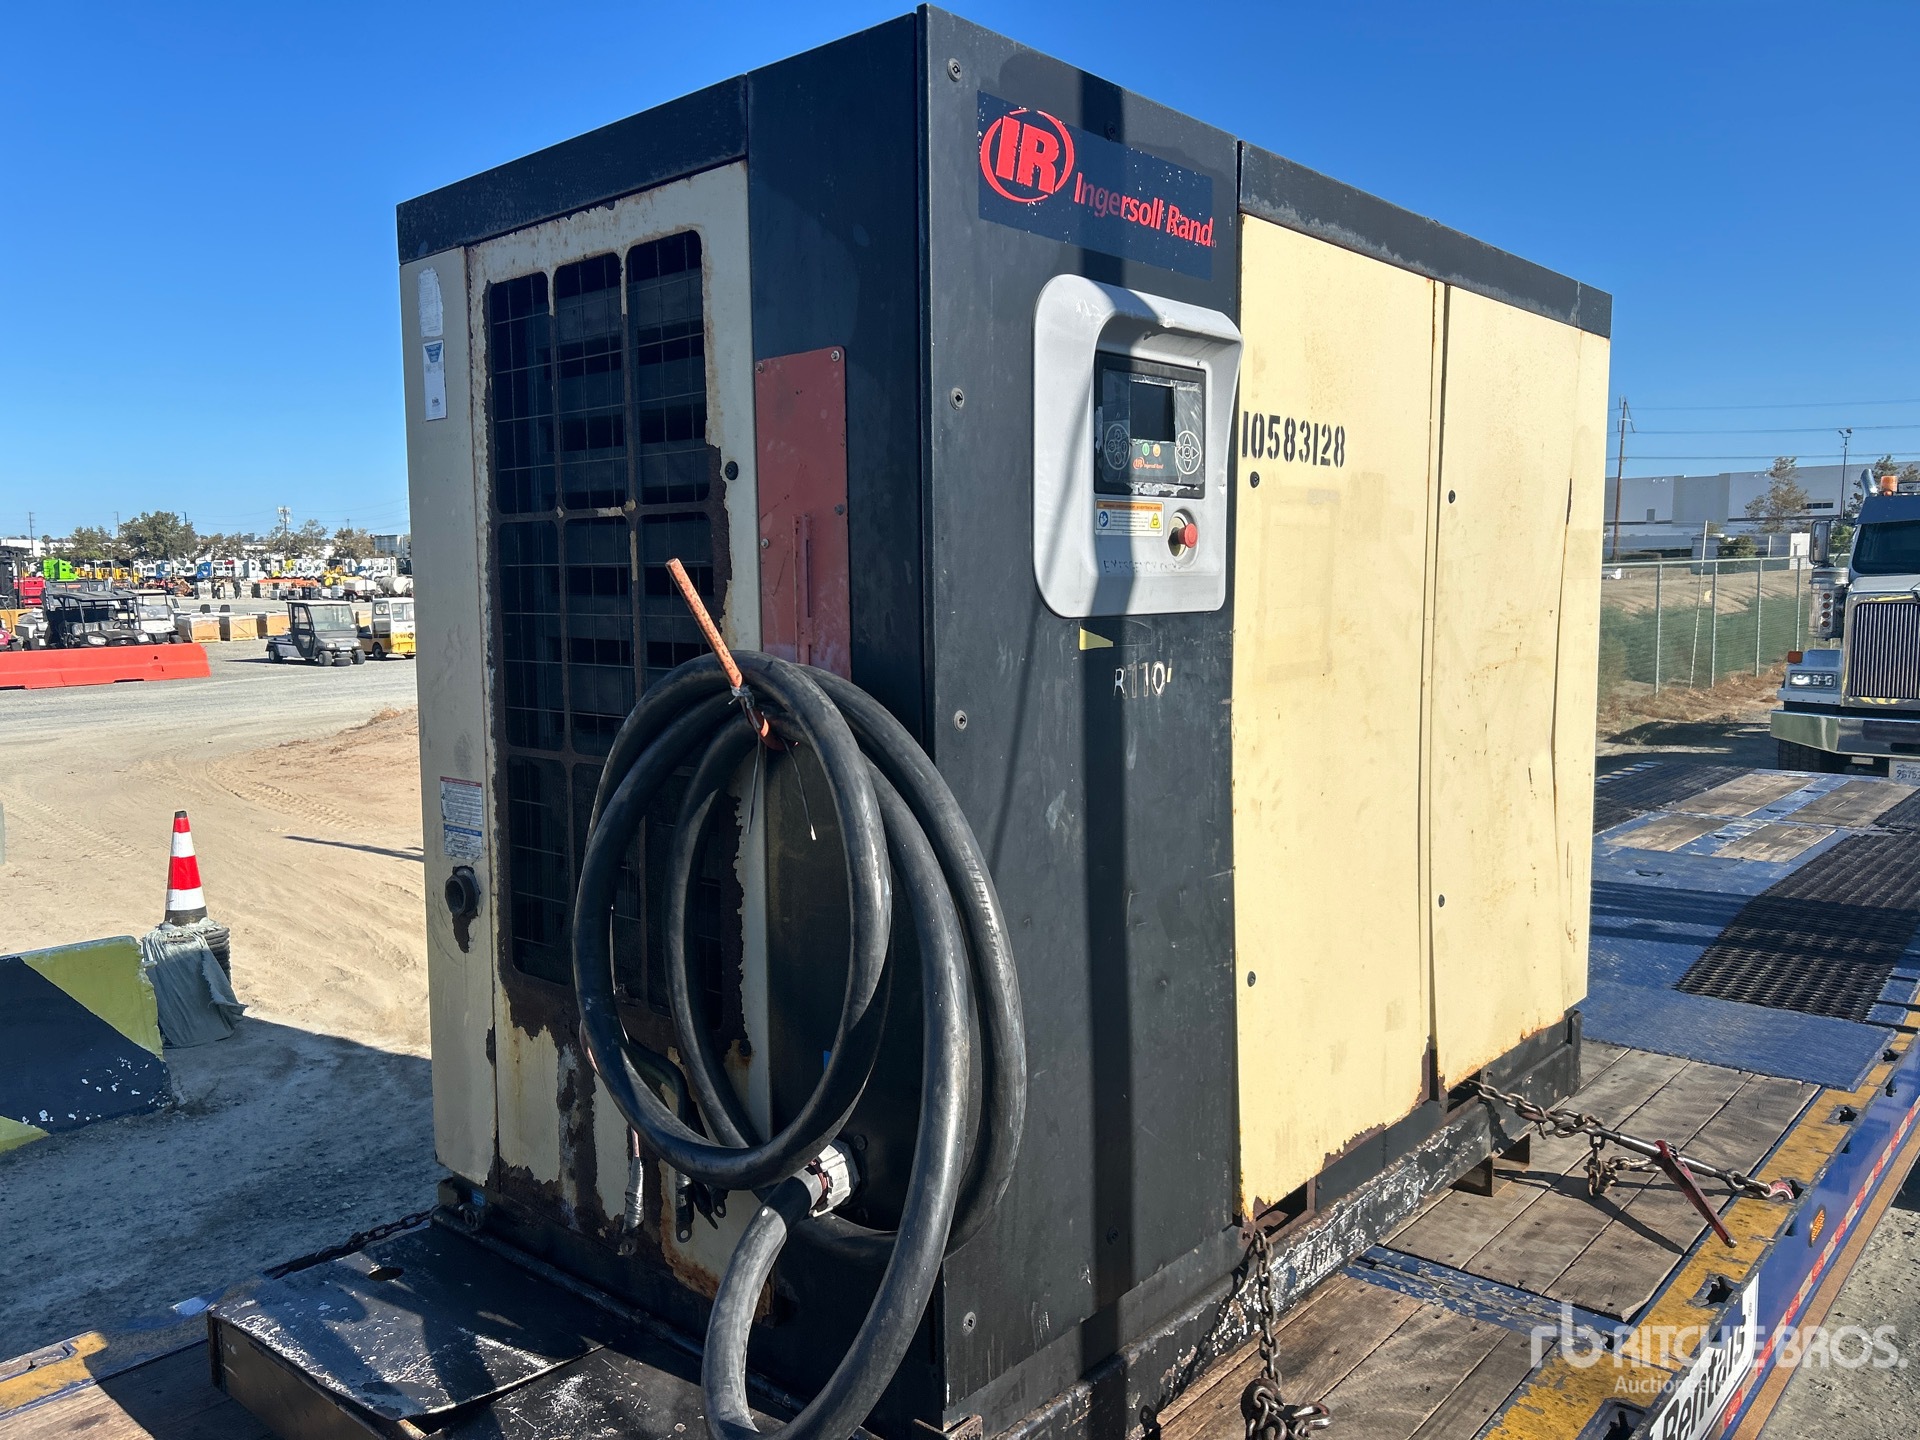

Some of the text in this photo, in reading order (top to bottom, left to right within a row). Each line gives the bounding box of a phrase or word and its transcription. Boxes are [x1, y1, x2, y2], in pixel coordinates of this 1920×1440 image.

[995, 115, 1060, 194] IR
[1074, 172, 1214, 247] Ingersoll Rand
[1242, 410, 1346, 468] 10583128
